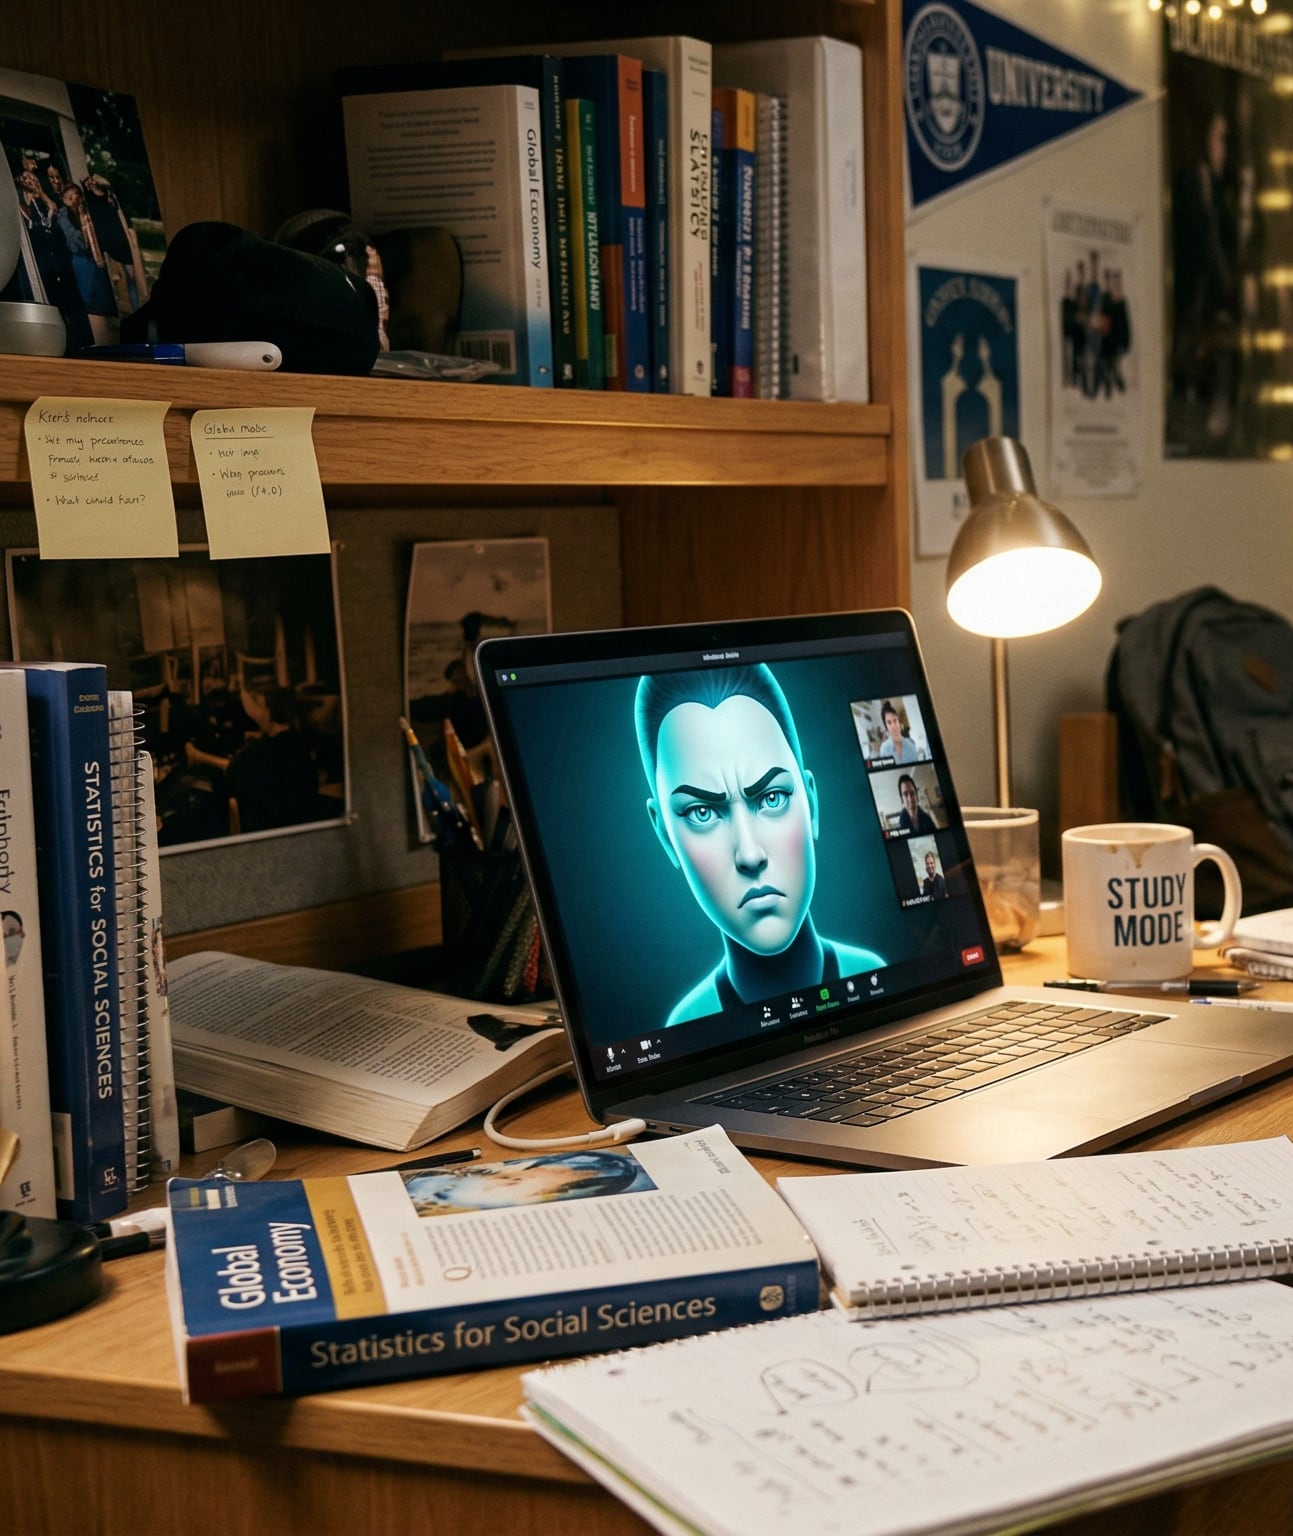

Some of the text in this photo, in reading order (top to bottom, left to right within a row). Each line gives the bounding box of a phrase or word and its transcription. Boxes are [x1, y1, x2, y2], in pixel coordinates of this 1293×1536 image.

[985, 45, 1106, 114] UNIVERSITY
[526, 128, 540, 182] Global
[1108, 872, 1186, 909] STUDY
[85, 762, 112, 1100] STATISTICS for SOCIAL SCIENCES
[1114, 910, 1184, 947] MODE
[212, 1244, 266, 1310] Global
[269, 1222, 317, 1304] Economy
[311, 1297, 717, 1368] Statistics for Social Sciences
